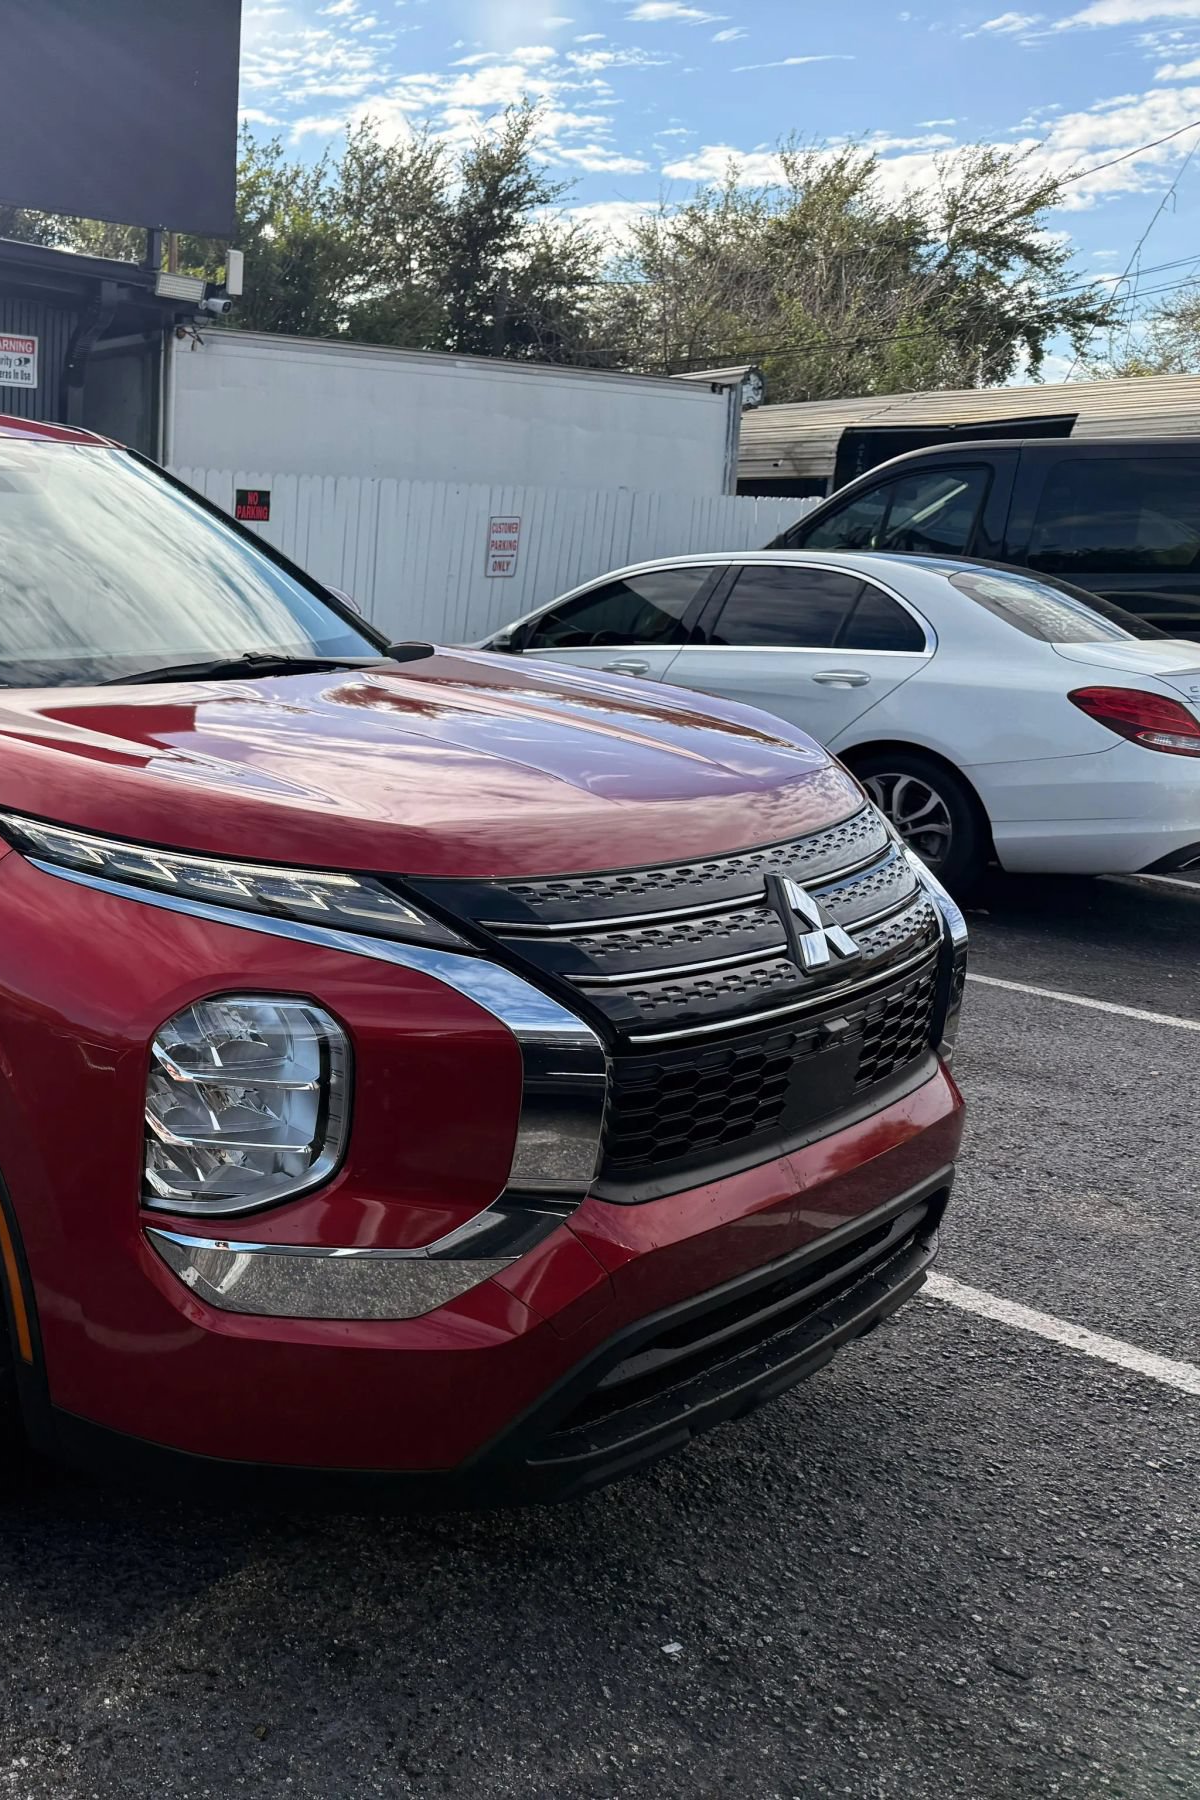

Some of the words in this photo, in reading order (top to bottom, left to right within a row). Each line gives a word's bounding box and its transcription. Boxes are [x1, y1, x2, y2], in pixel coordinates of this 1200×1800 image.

[13, 369, 19, 380] In
[20, 370, 31, 381] Use
[247, 491, 259, 505] NO
[237, 505, 268, 520] PARKING
[492, 522, 519, 534] CUSTOMER
[490, 540, 517, 551] PARKING
[492, 560, 511, 572] ONLY
